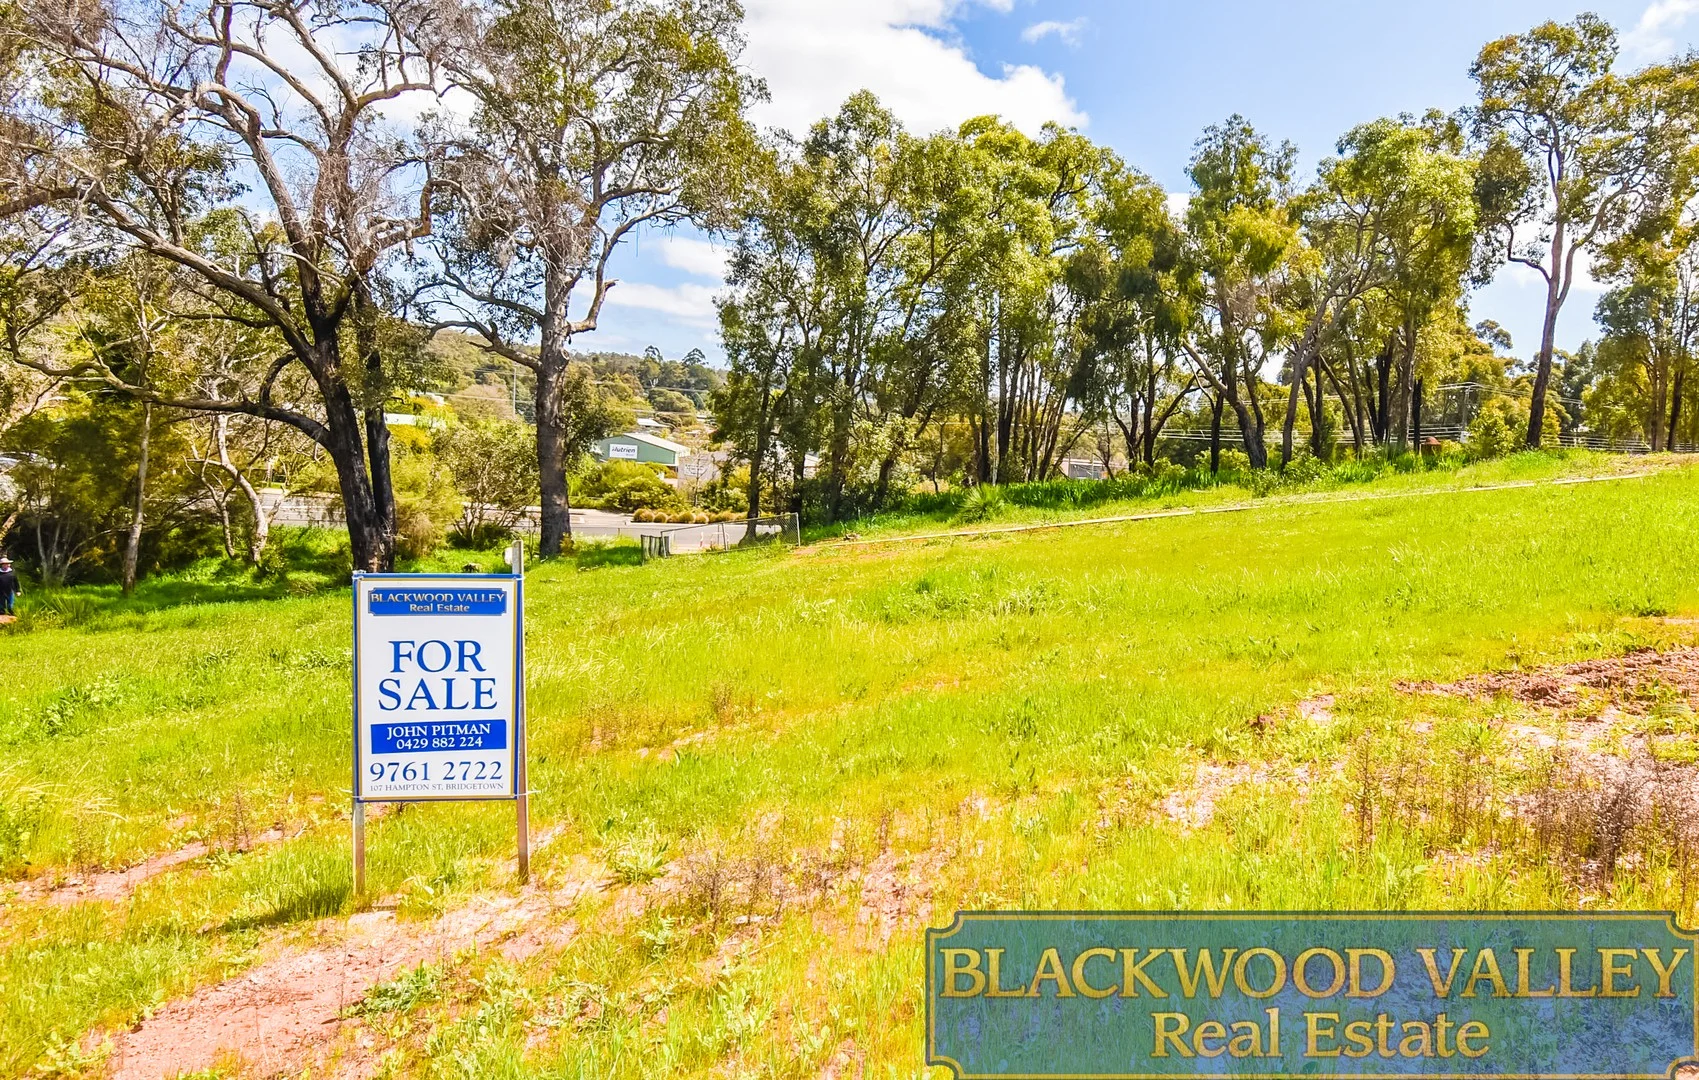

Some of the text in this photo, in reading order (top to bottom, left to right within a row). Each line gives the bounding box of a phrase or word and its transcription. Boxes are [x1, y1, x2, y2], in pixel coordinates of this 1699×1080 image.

[371, 593, 505, 602] BLACKWOOD VALLEY
[409, 603, 470, 612] Real Estate
[388, 639, 487, 673] FOR
[378, 677, 498, 711] SALE
[386, 723, 491, 740] JOHN PITMAN
[396, 736, 483, 750] 0429 882 224
[369, 761, 503, 782] 9761 2722
[370, 784, 383, 792] 107
[385, 783, 430, 791] HAMPTON
[445, 782, 504, 791] BRIDGETOWN
